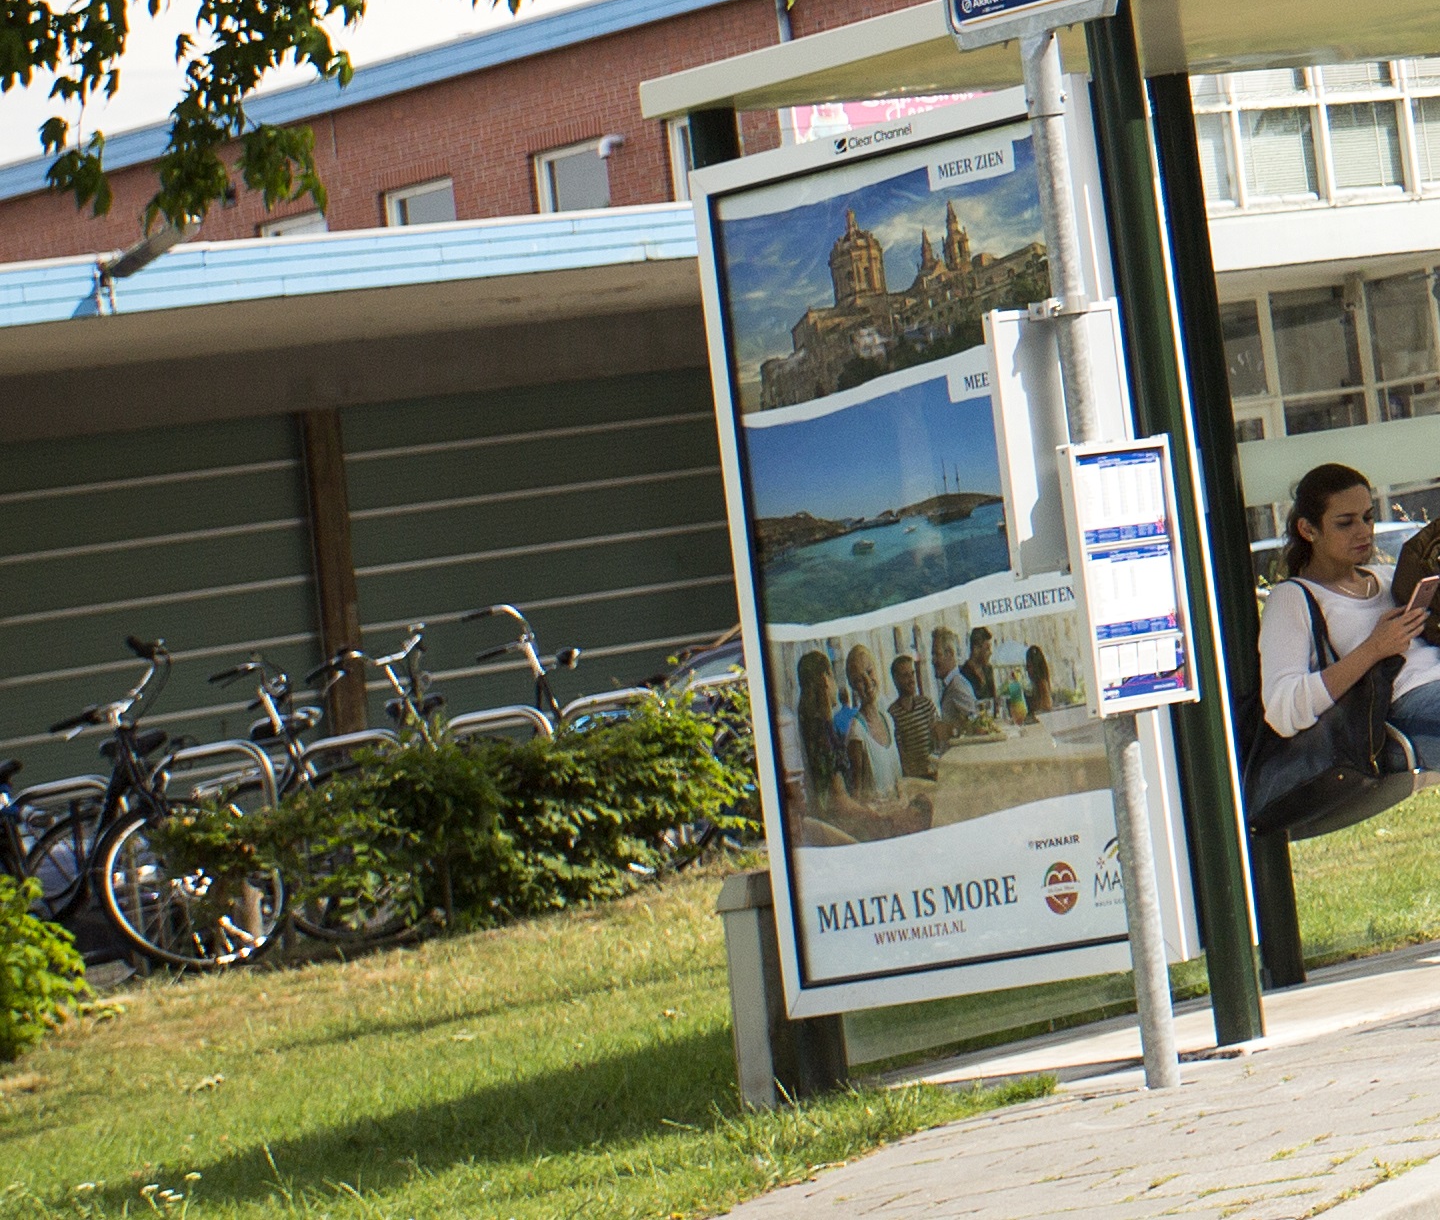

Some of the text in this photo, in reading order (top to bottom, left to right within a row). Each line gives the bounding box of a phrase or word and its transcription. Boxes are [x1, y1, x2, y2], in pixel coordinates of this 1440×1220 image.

[848, 123, 913, 150] Clear Channel
[937, 150, 1005, 180] MEER ZIEN
[979, 596, 1014, 618] MEER
[1034, 834, 1081, 851] RYANAIR
[817, 875, 1019, 934] MALTA IS MORE
[873, 919, 967, 946] WWW.MALTA.NL
